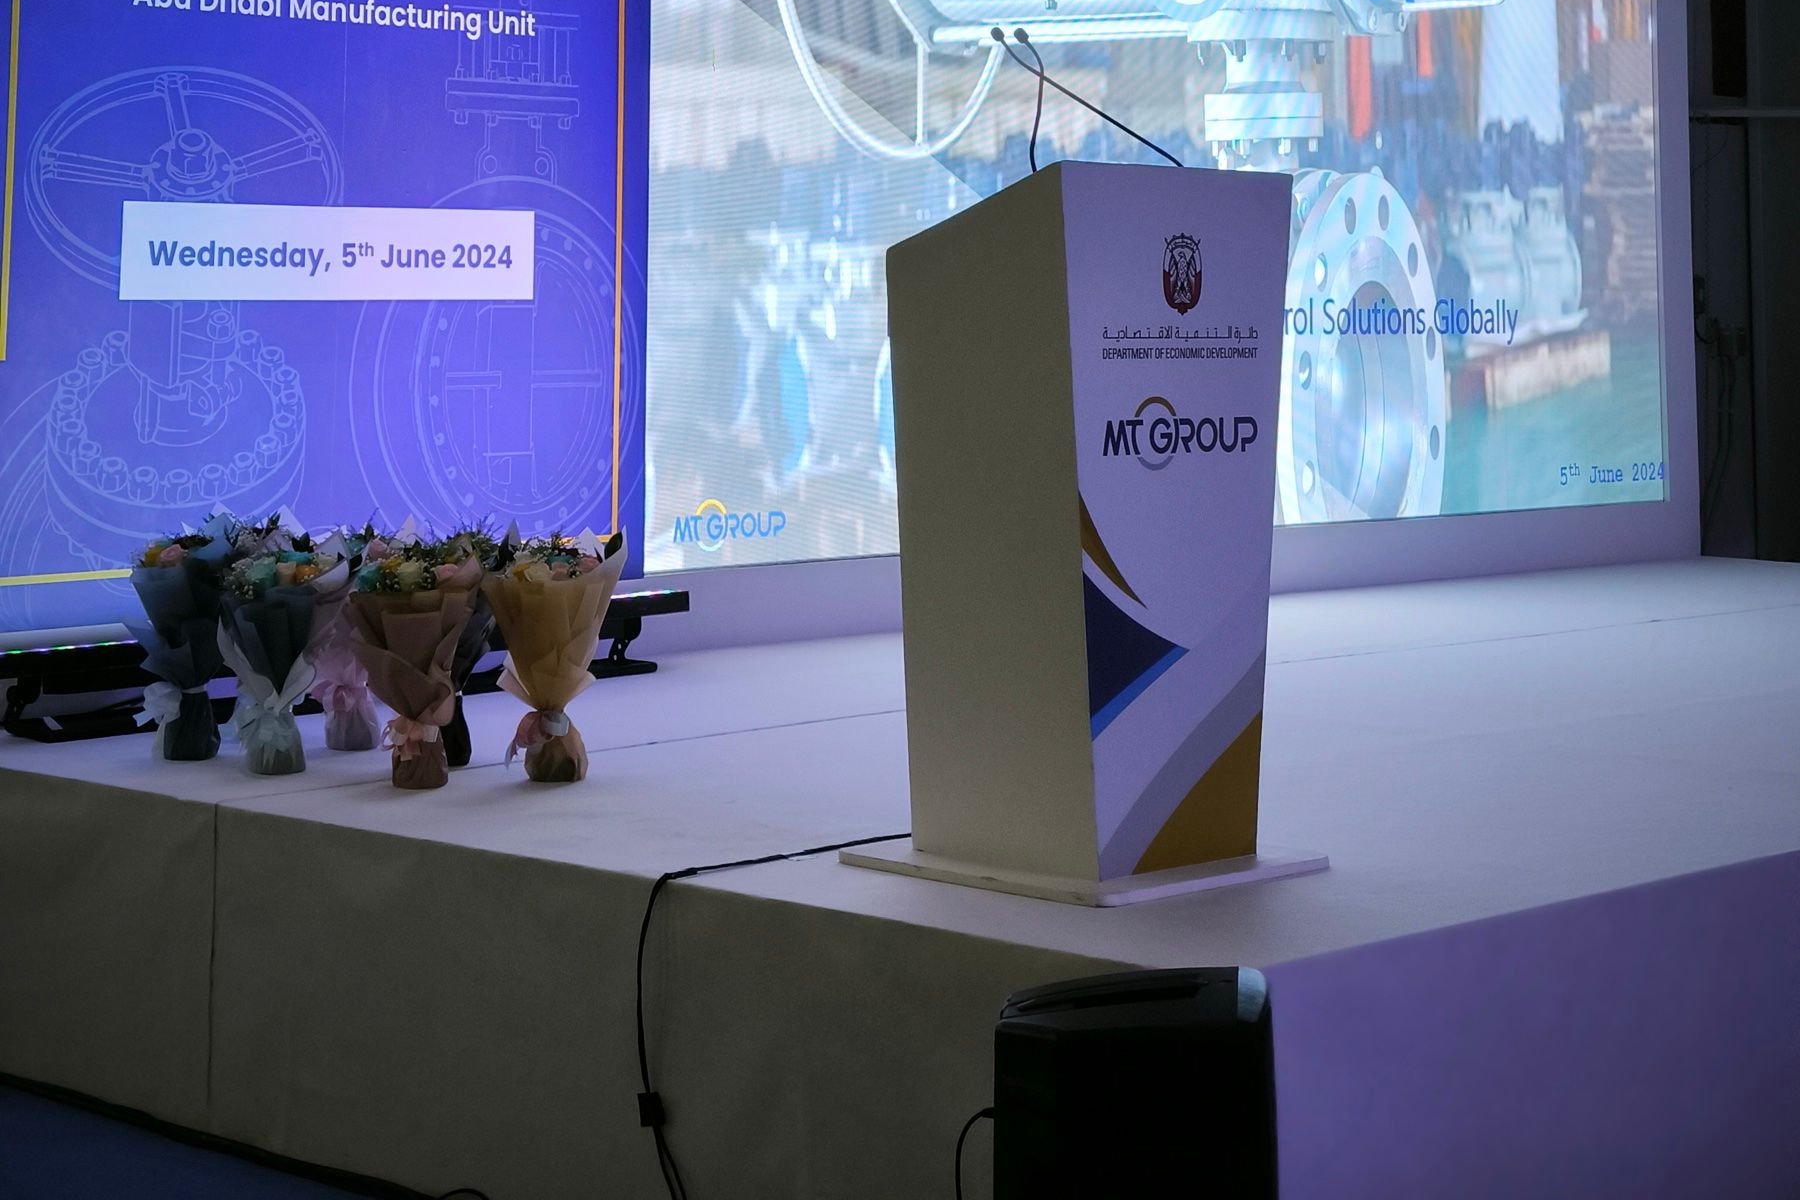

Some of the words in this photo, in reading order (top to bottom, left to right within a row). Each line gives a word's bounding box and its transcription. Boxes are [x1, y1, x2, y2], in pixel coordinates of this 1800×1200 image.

[488, 9, 536, 36] Unit
[149, 240, 331, 277] Wednesday,
[342, 242, 375, 268] 5th
[381, 244, 446, 269] June
[452, 243, 513, 269] 2024
[1102, 325, 1173, 343] الاقتصادية
[1174, 325, 1232, 343] التنمية
[1322, 298, 1426, 336] Solutions
[1433, 298, 1519, 346] Globally
[1102, 347, 1153, 360] DEPARTMENT
[1154, 347, 1164, 360] OF
[1165, 347, 1205, 360] ECONOMIC
[1206, 347, 1259, 360] DEVELOPMENT
[1103, 419, 1144, 456] MT
[1149, 416, 1258, 454] GROUP
[1560, 463, 1580, 486] 5th
[1589, 465, 1624, 484] June
[1632, 462, 1664, 481] 2024
[673, 516, 703, 543] MT
[706, 511, 787, 540] GROUP
